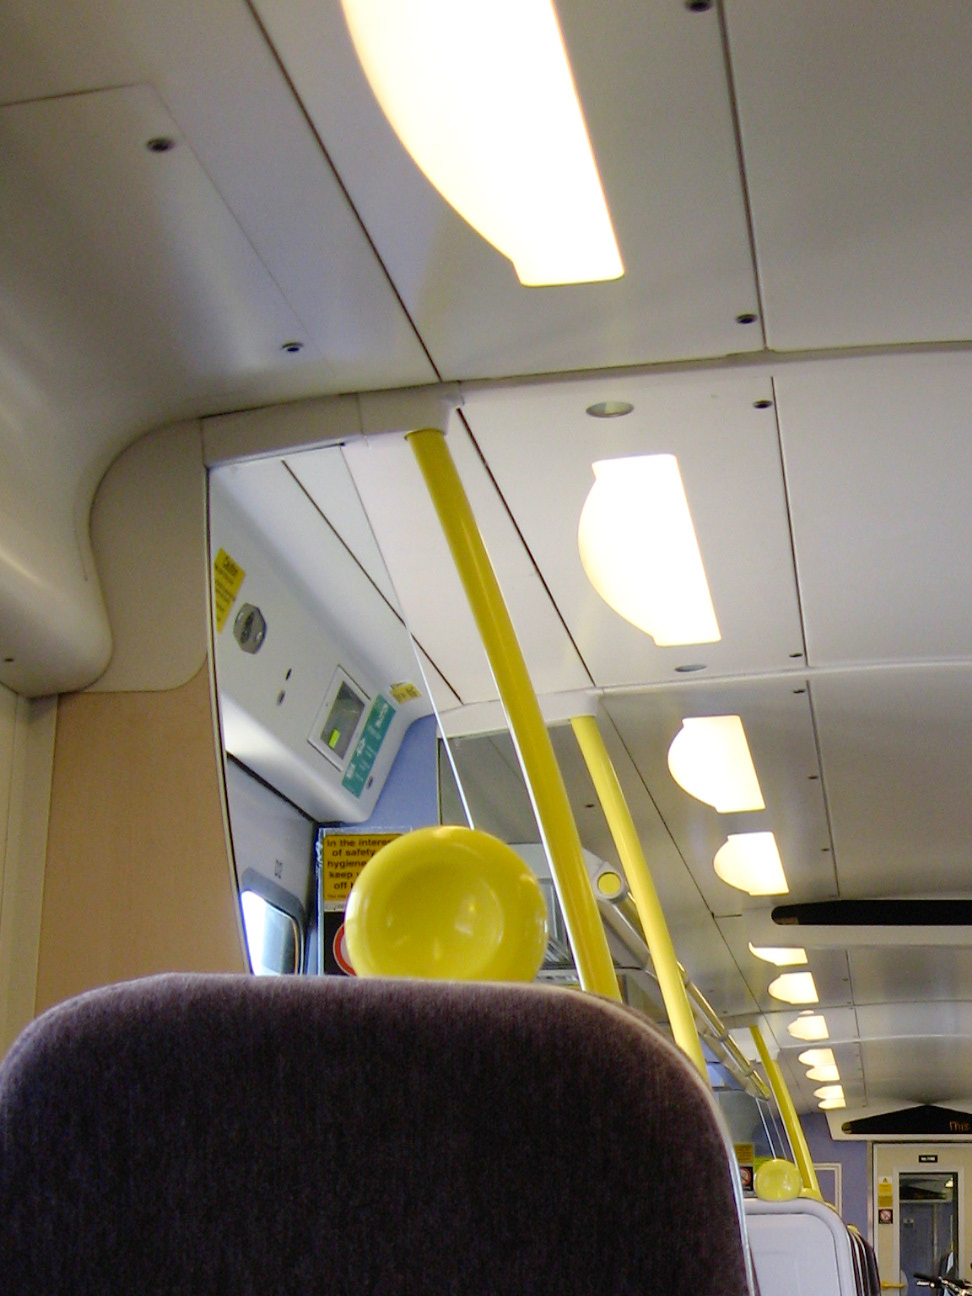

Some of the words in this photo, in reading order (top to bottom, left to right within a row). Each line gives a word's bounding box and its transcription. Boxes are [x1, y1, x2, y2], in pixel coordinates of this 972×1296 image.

[327, 839, 336, 847] In
[340, 839, 356, 847] the
[358, 839, 392, 847] intere
[346, 848, 376, 857] safety
